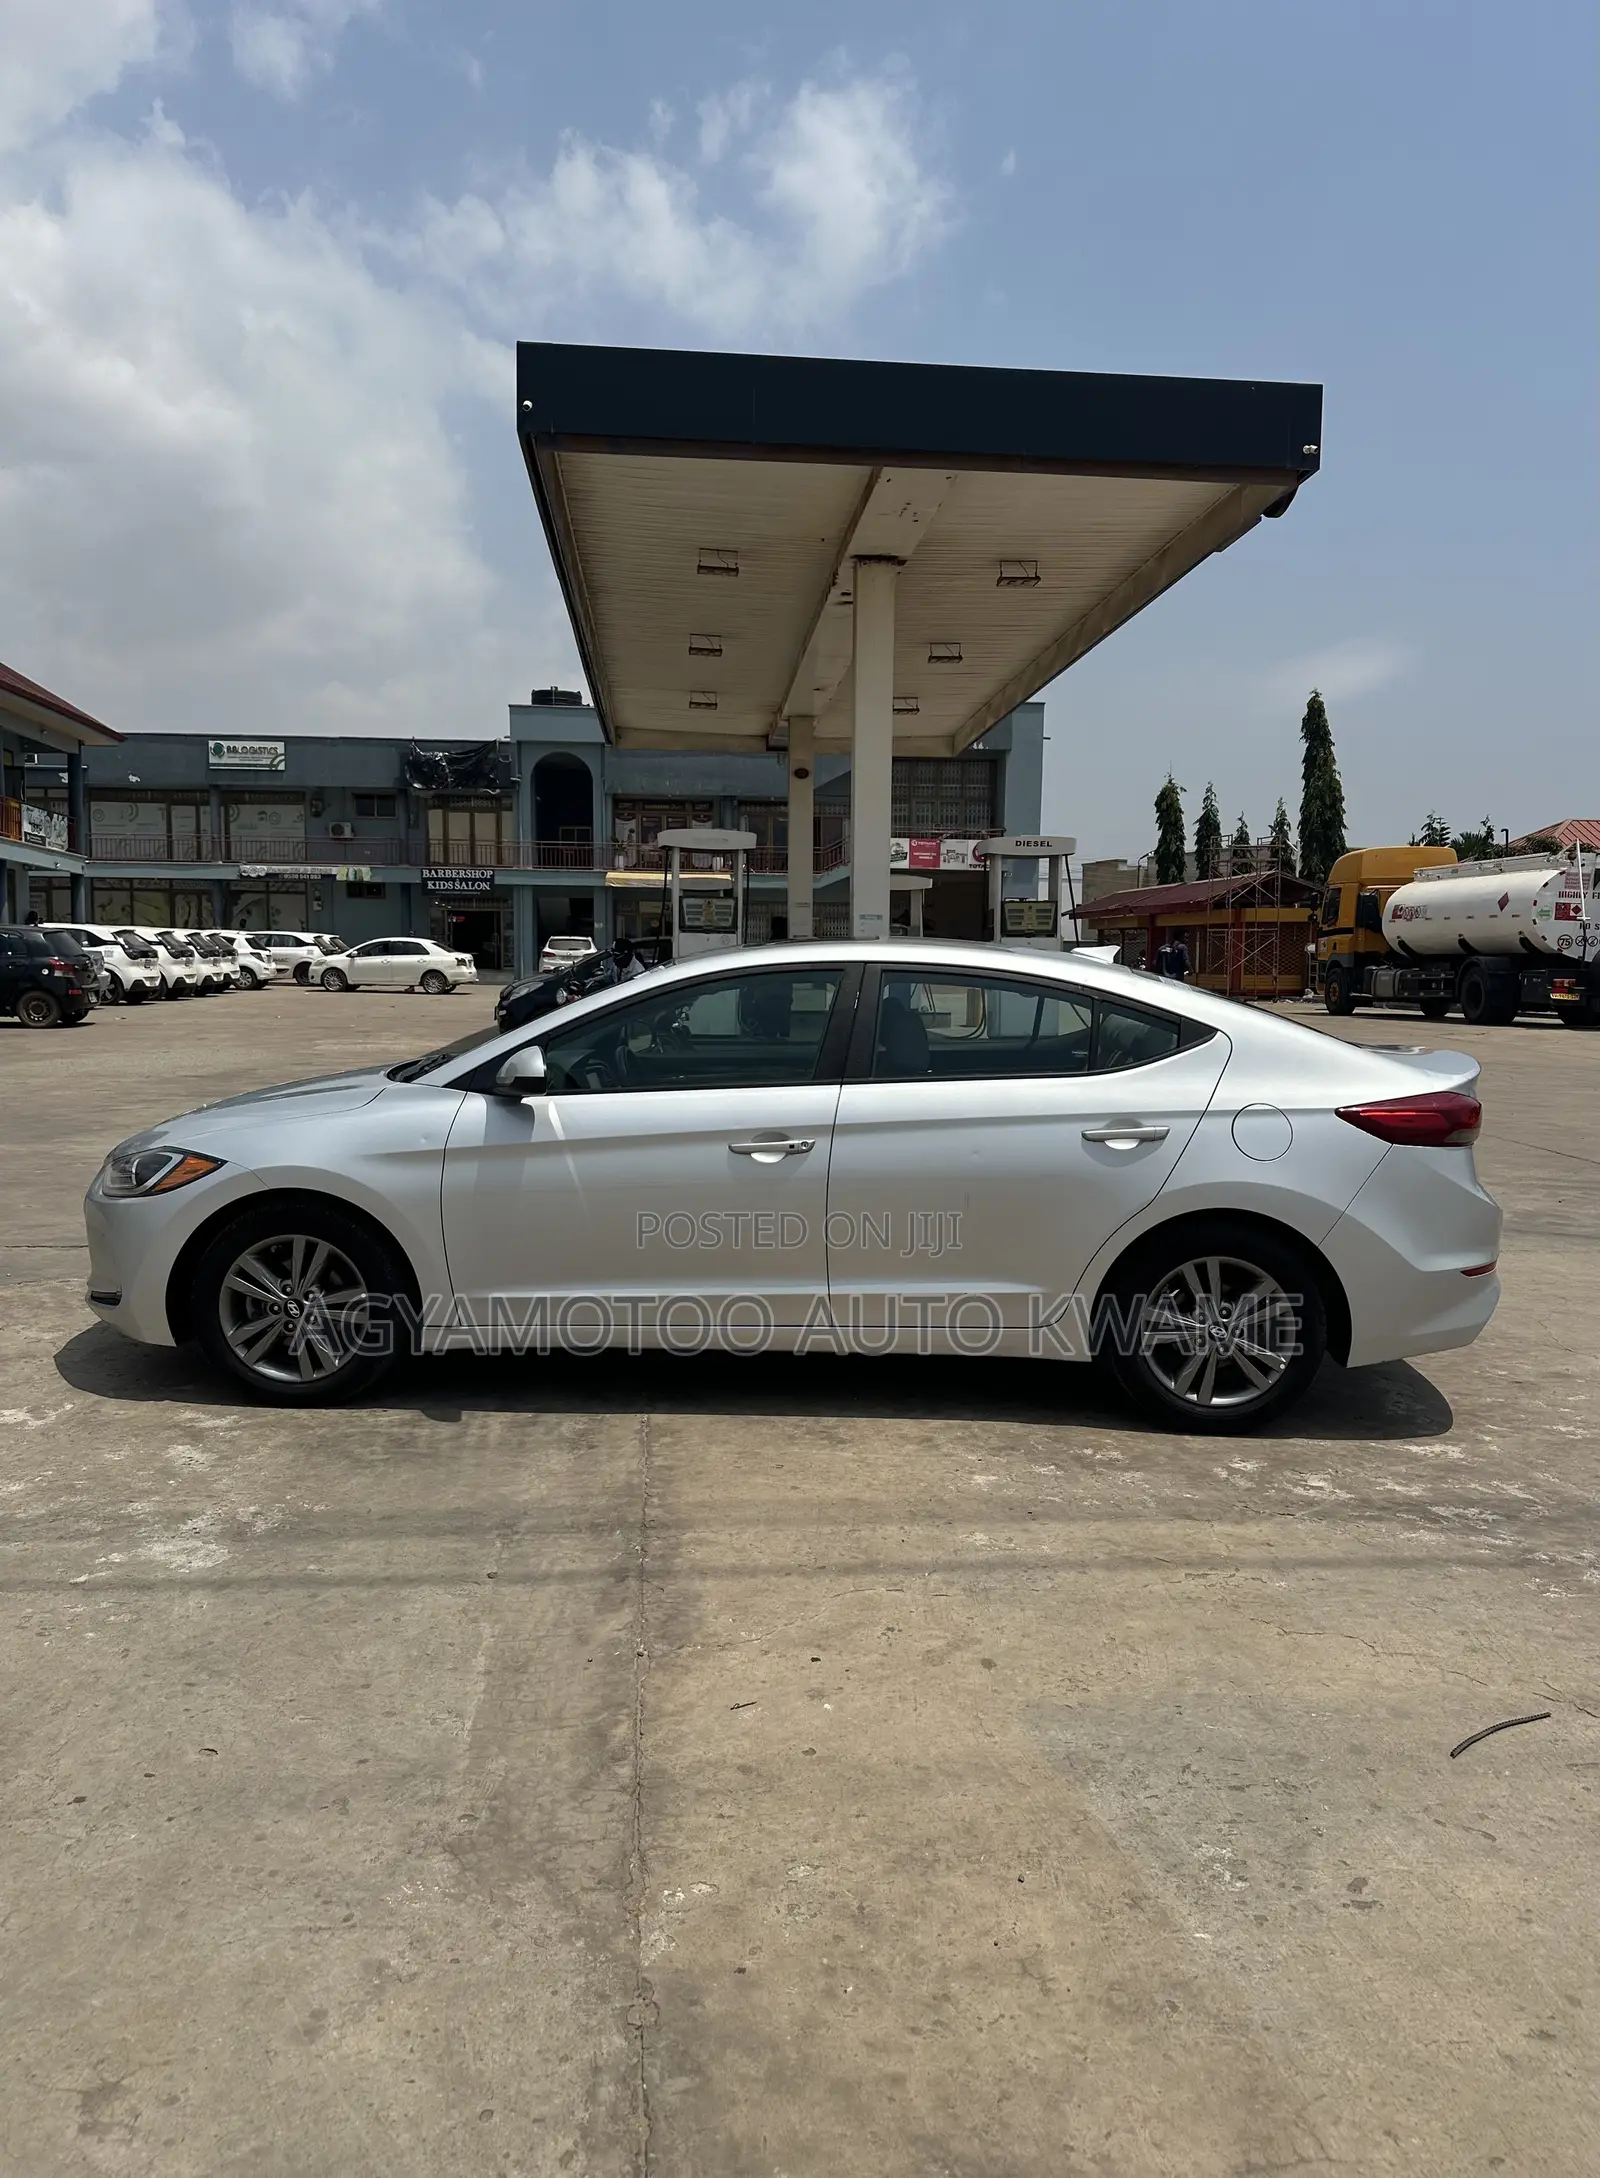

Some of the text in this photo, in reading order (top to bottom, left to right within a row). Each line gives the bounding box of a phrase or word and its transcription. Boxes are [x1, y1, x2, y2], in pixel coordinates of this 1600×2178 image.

[1015, 840, 1053, 848] DIESEL
[422, 869, 493, 879] BARBERSHOP
[427, 880, 491, 891] KIDS SALON
[1559, 937, 1571, 946] 75
